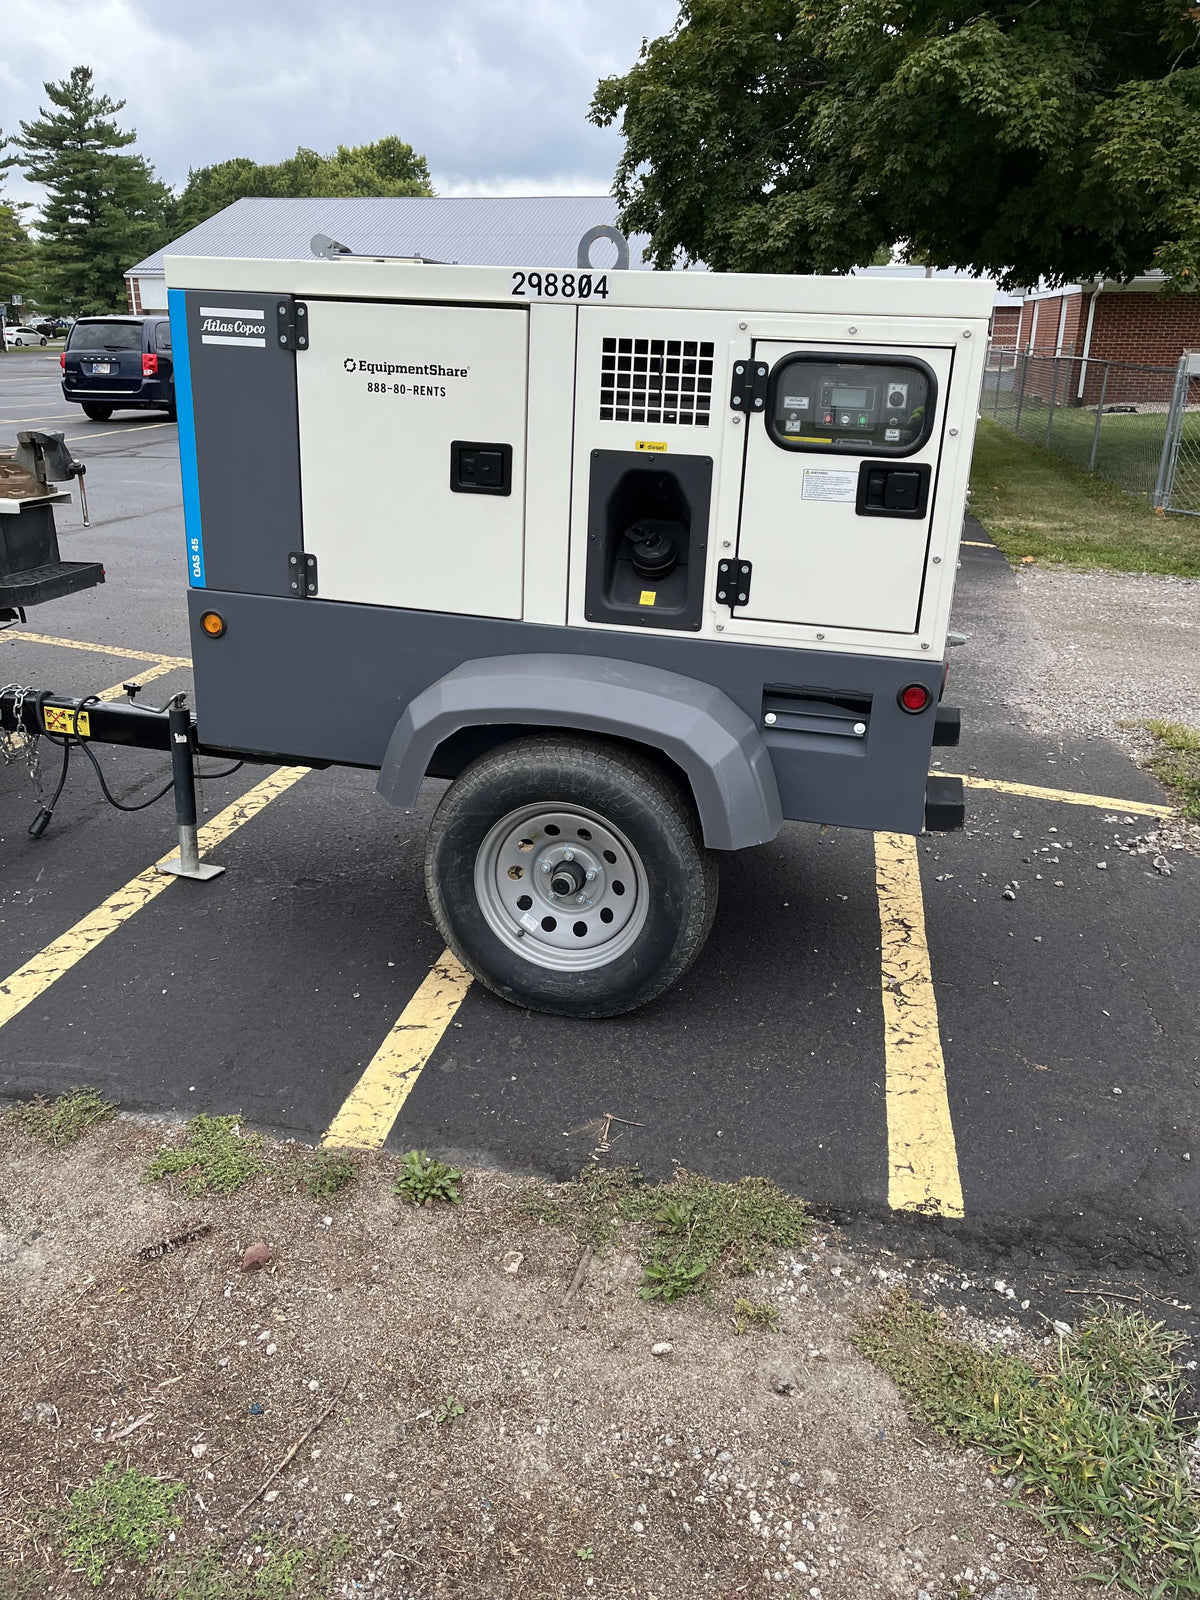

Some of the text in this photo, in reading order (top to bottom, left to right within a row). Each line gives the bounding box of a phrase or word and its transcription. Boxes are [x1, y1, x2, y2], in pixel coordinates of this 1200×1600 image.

[512, 271, 609, 299] 298804
[358, 360, 468, 378] EquipmentShare
[367, 382, 446, 397] 888-80-RENTS
[191, 537, 201, 578] QAS 45
